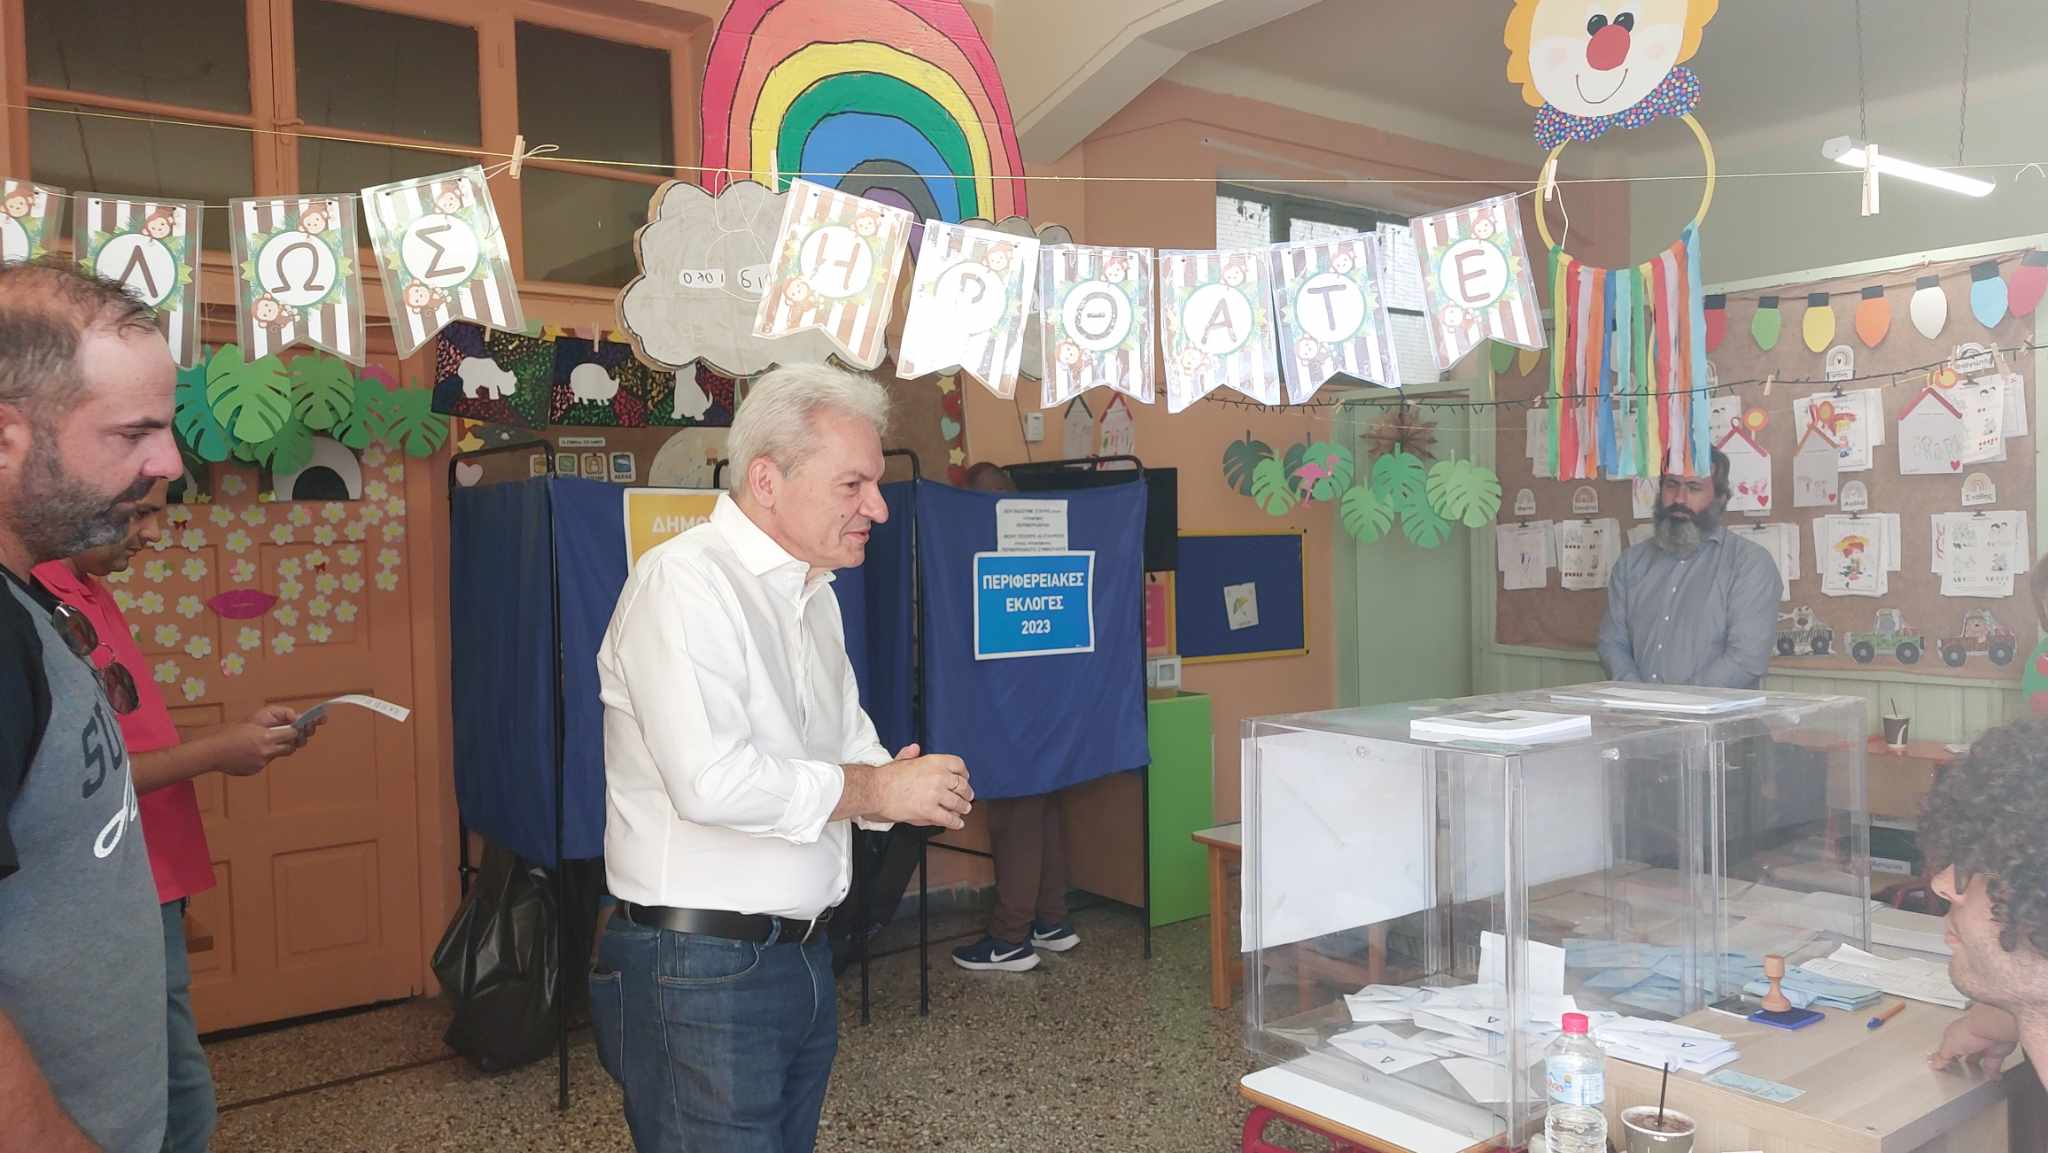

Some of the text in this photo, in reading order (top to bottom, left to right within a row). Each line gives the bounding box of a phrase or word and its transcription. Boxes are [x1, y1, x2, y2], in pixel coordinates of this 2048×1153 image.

[982, 572, 1085, 590] ΠΕΡΙΦΕΡΕΙΑΚΕΣ
[1006, 595, 1064, 613] ΕΚΛΟΓΕΣ
[1021, 619, 1051, 635] 2023
